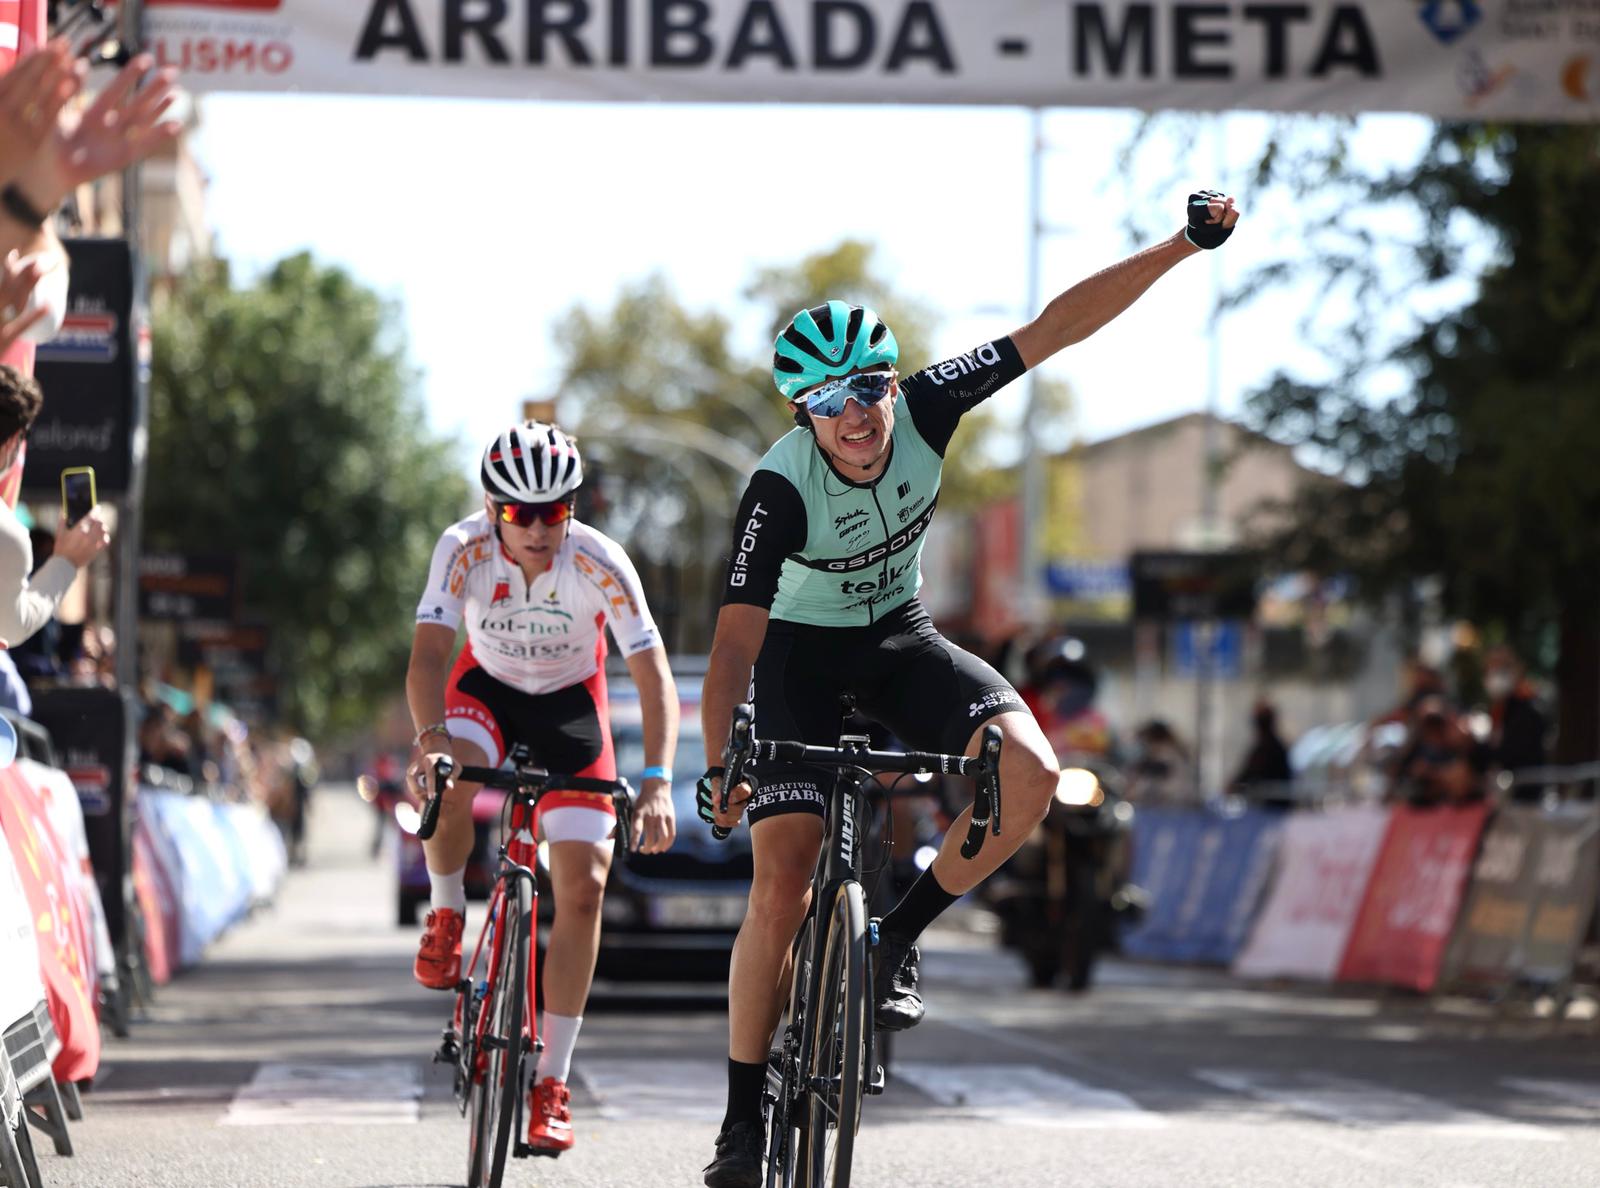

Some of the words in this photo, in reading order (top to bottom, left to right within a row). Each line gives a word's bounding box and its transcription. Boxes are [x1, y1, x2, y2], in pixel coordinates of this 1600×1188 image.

[148, 38, 294, 75] LISMO
[352, 0, 958, 74] ARRIBADA
[1071, 2, 1382, 79] META
[828, 505, 935, 570] GSPORT
[755, 782, 817, 796] CREATIVOS
